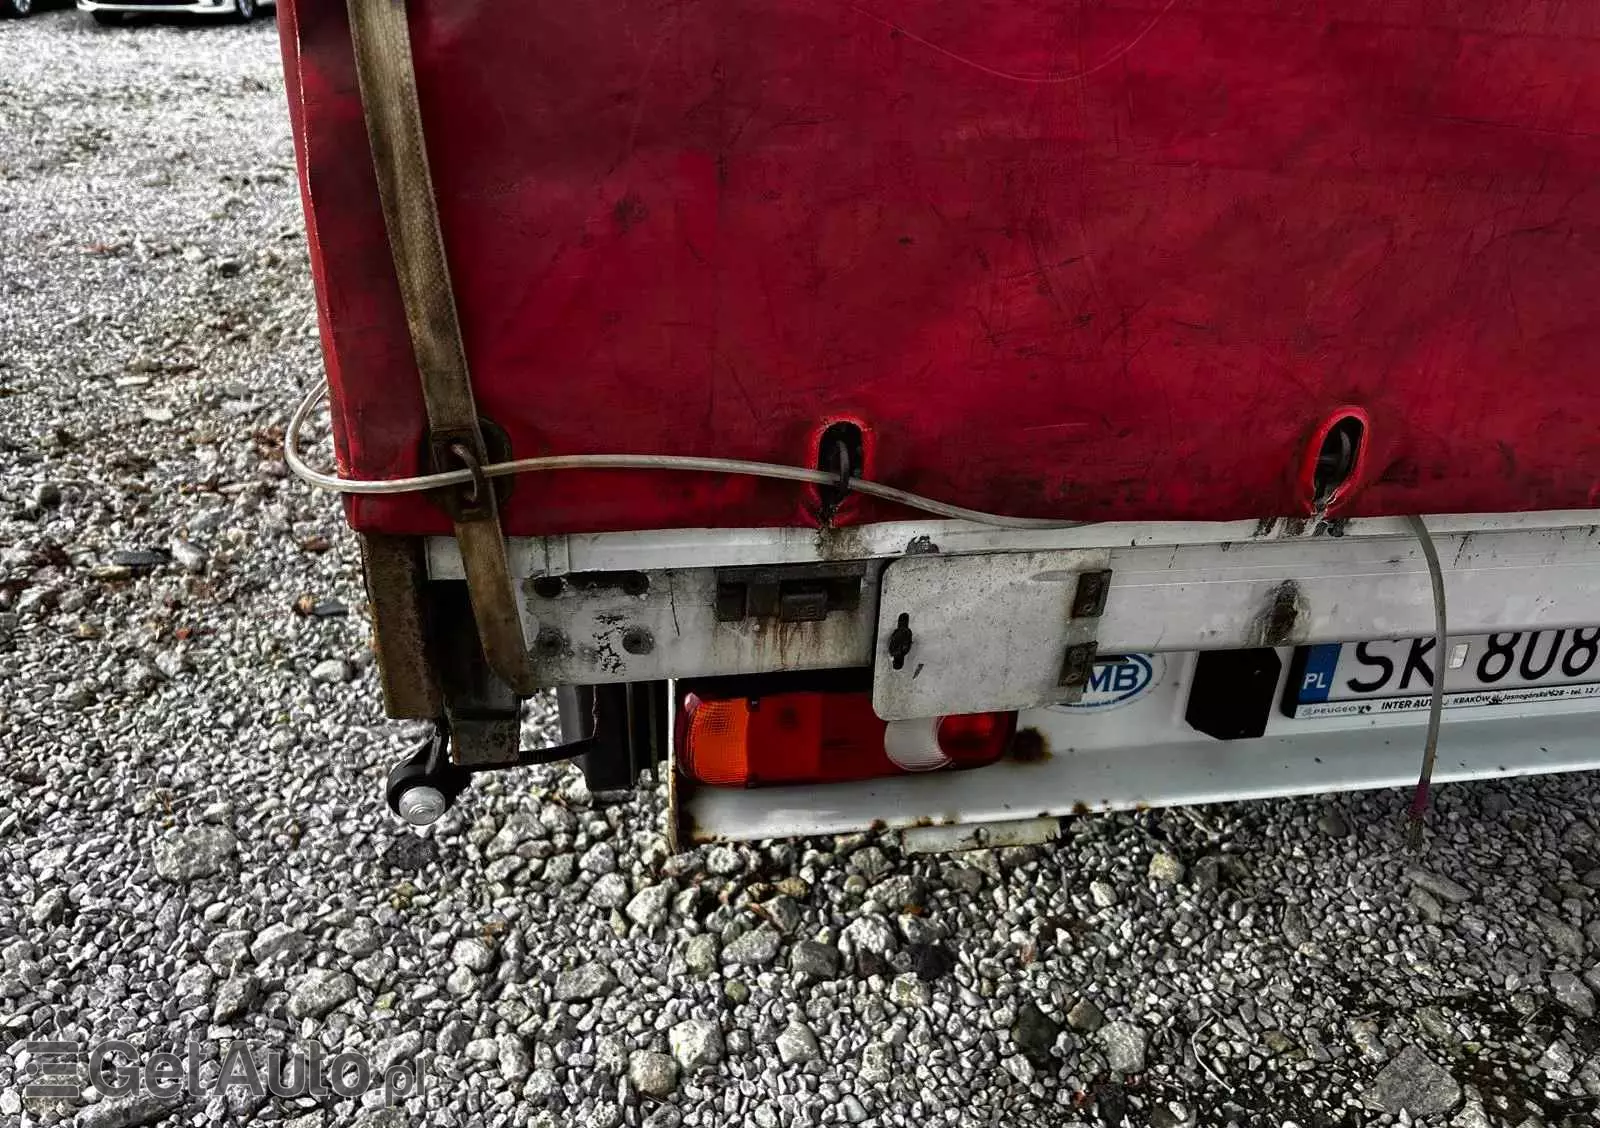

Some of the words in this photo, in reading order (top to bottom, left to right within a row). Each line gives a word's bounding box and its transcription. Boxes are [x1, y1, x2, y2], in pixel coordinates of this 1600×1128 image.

[1477, 627, 1600, 684] 808
[1303, 673, 1327, 690] PL
[1381, 700, 1411, 711] INTER
